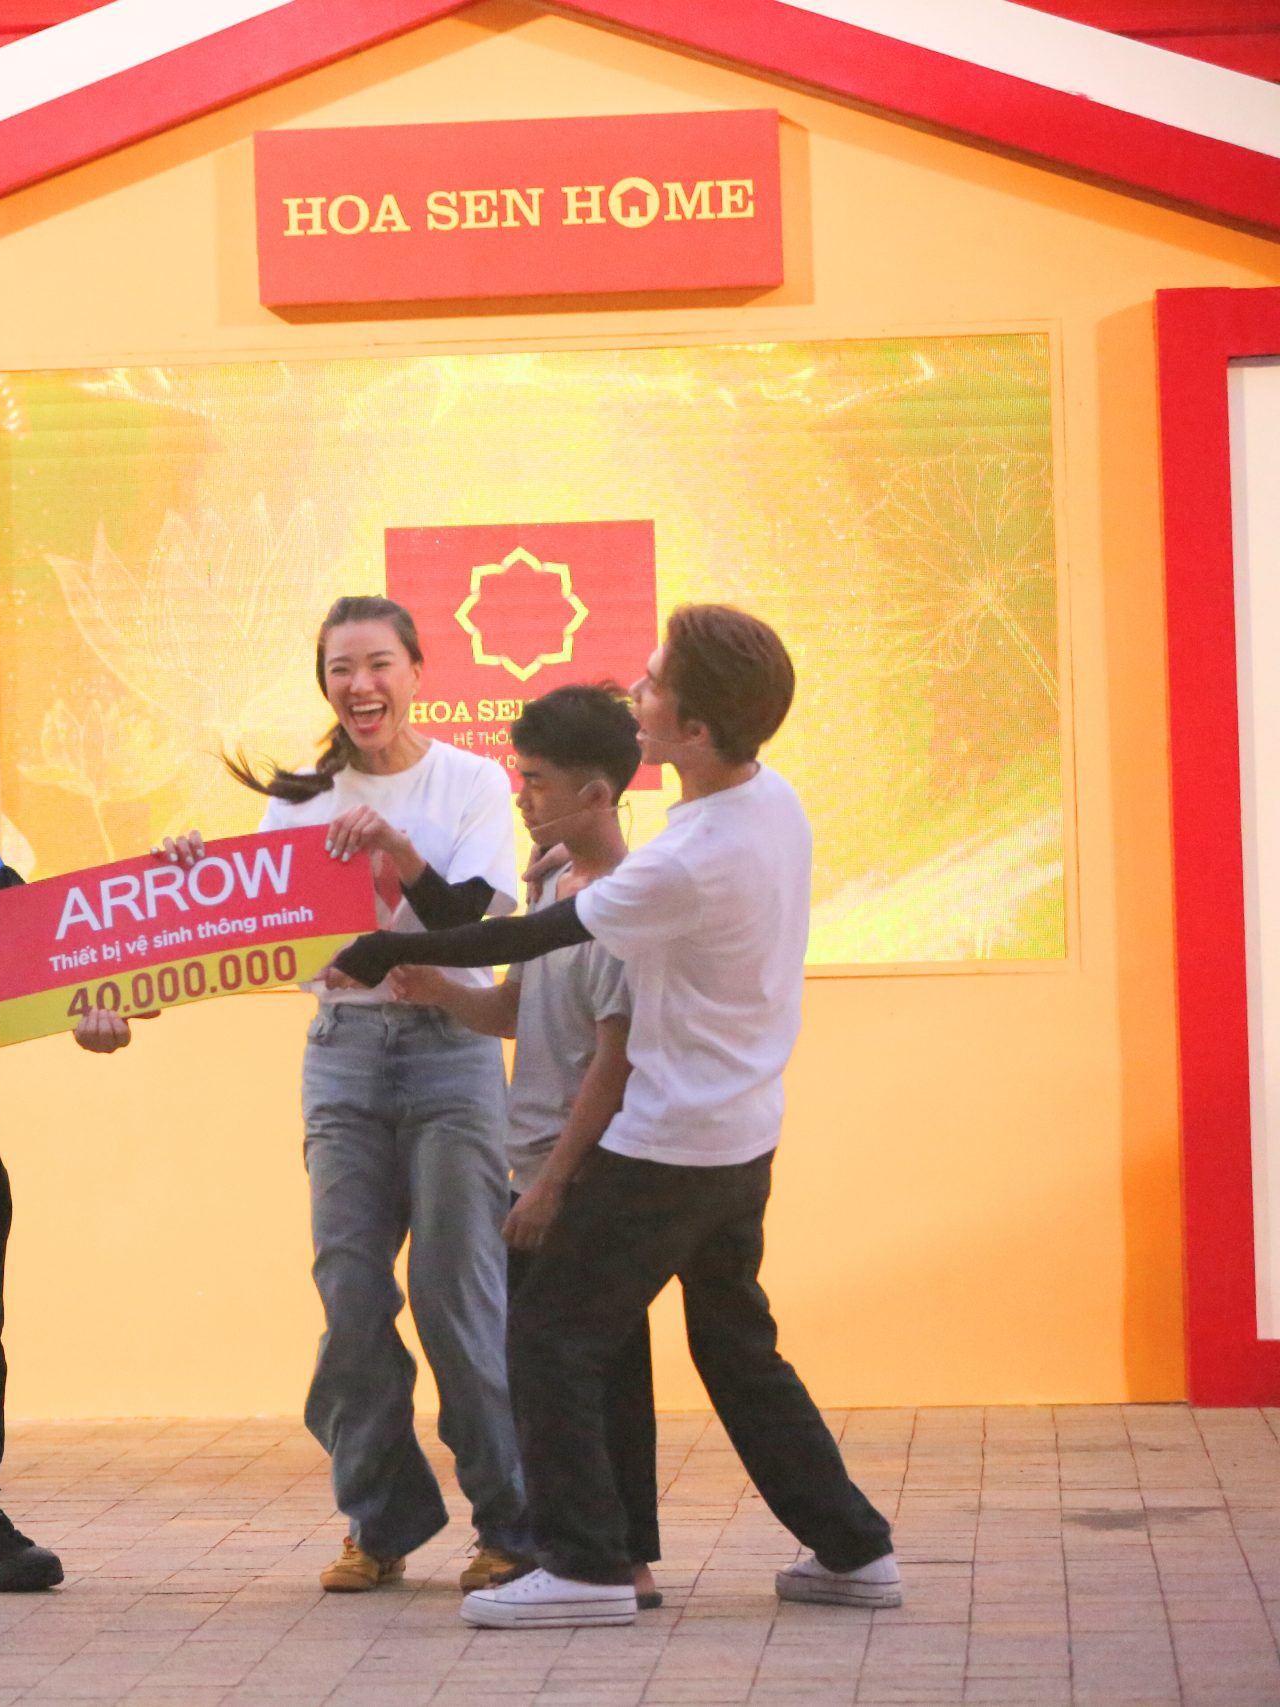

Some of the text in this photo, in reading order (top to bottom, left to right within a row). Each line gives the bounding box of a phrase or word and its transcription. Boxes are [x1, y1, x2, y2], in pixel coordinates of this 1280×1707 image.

[283, 176, 755, 237] HOA SEN HOME
[409, 701, 472, 724] HOA
[453, 727, 512, 749] HỆ THỐ
[55, 844, 293, 940] ARROW
[48, 906, 314, 972] Thiết bị vệ sinh thông minh
[66, 945, 298, 1018] 40.000.000
